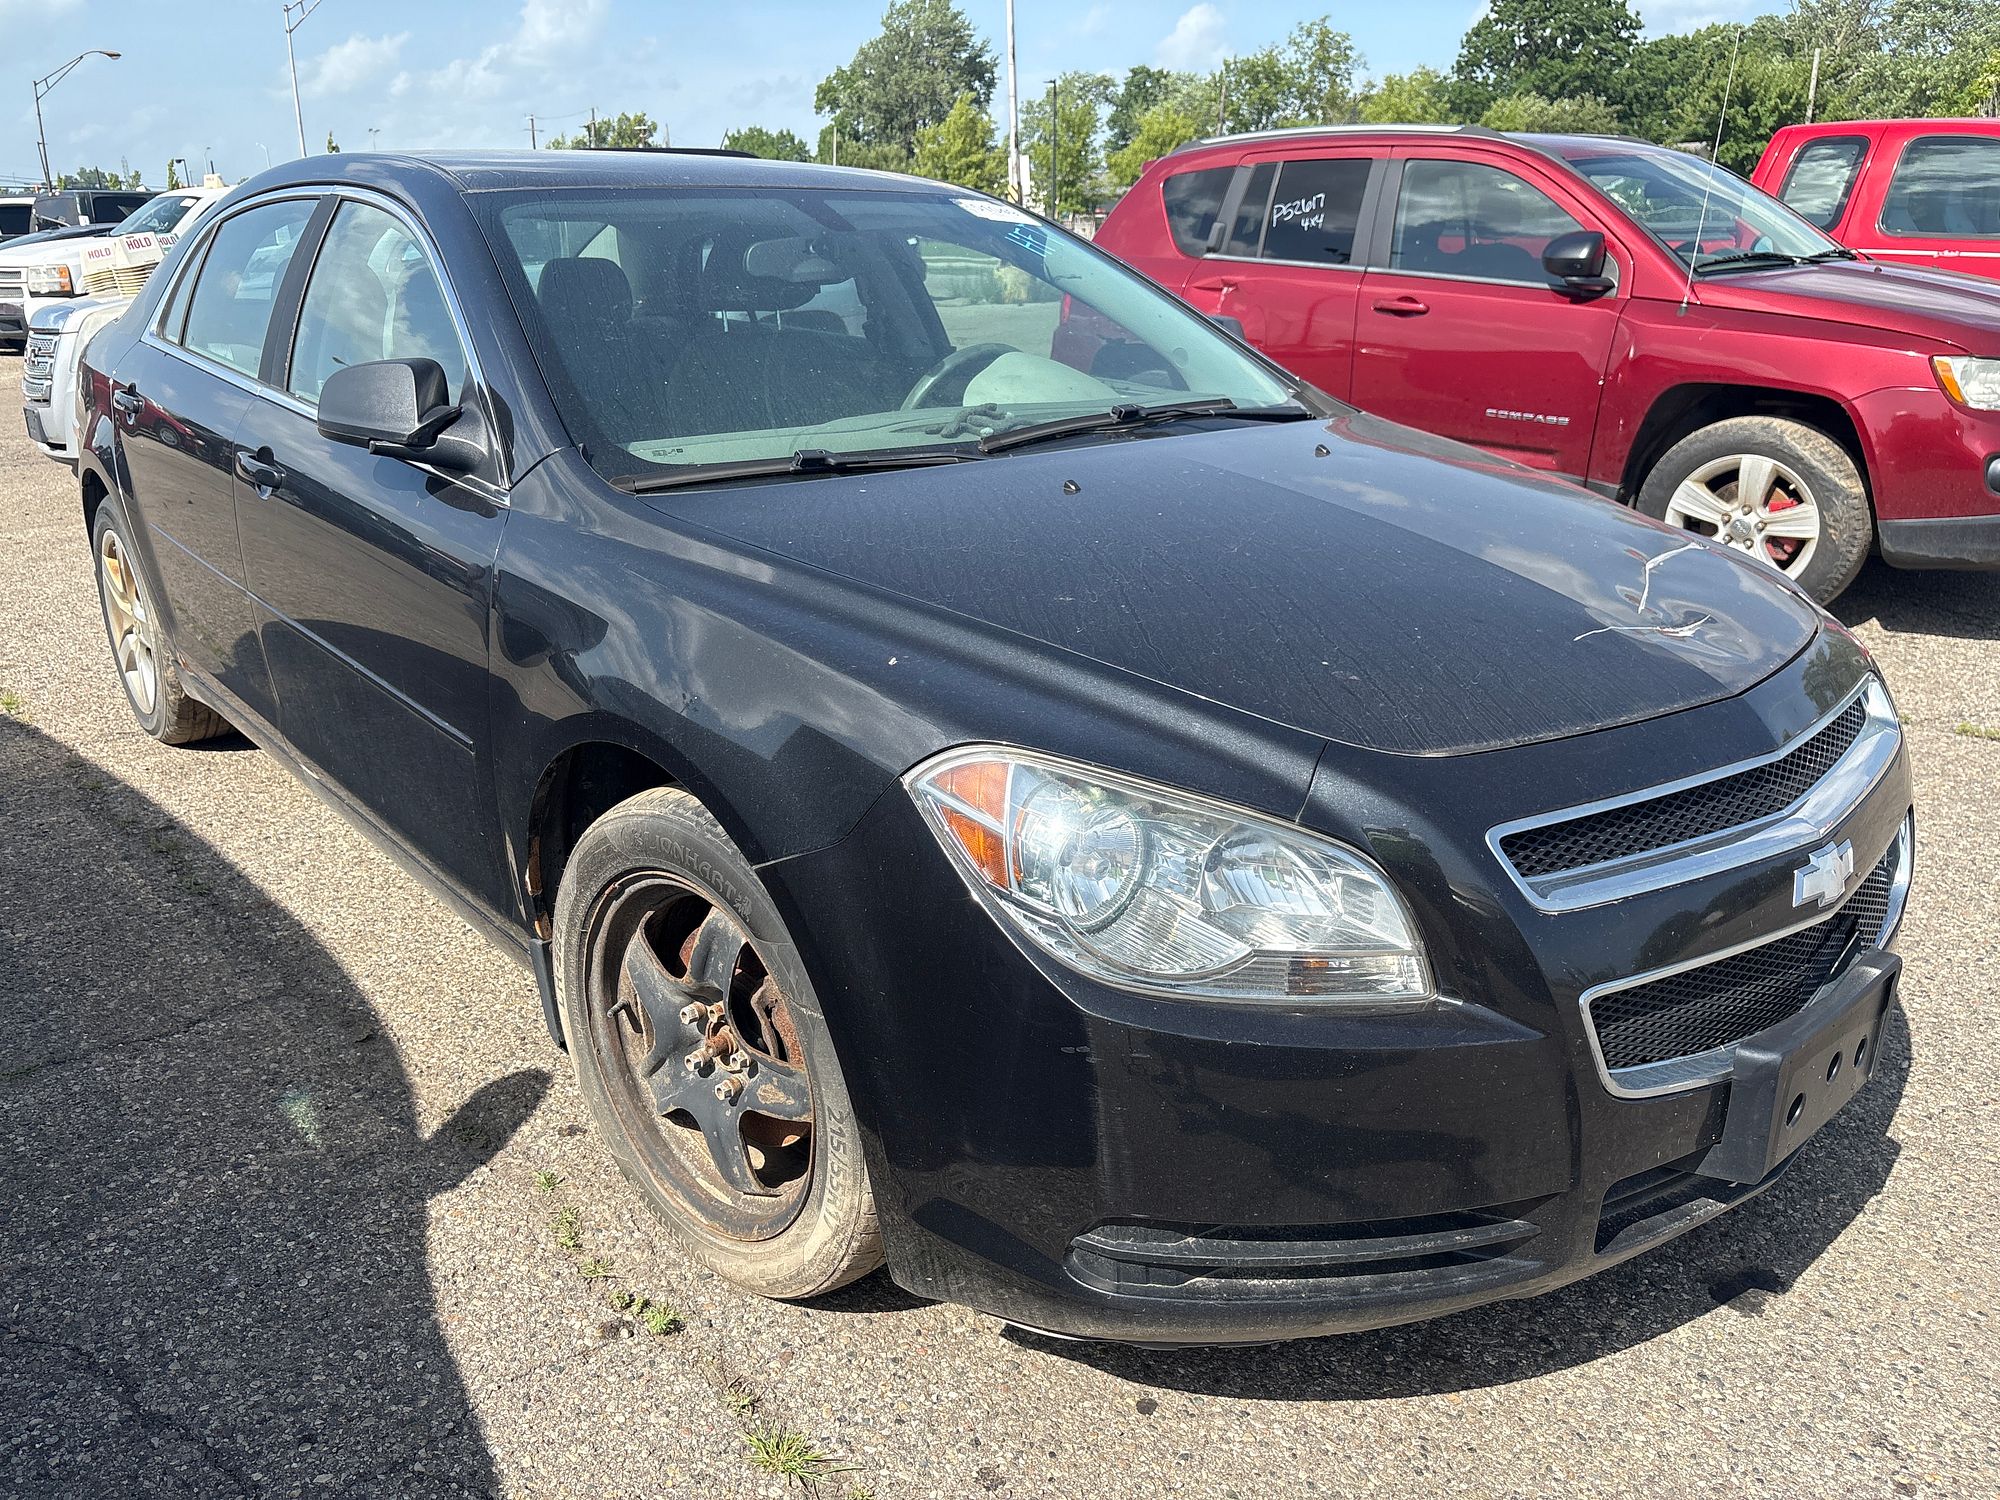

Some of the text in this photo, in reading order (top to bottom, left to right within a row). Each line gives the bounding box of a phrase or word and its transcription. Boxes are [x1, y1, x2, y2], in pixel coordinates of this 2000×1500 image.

[125, 236, 152, 250] HOLD
[87, 247, 112, 259] HOLD
[1485, 408, 1570, 425] COMPASS
[644, 831, 738, 902] LIONHART
[824, 1105, 850, 1232] 215/55R17
